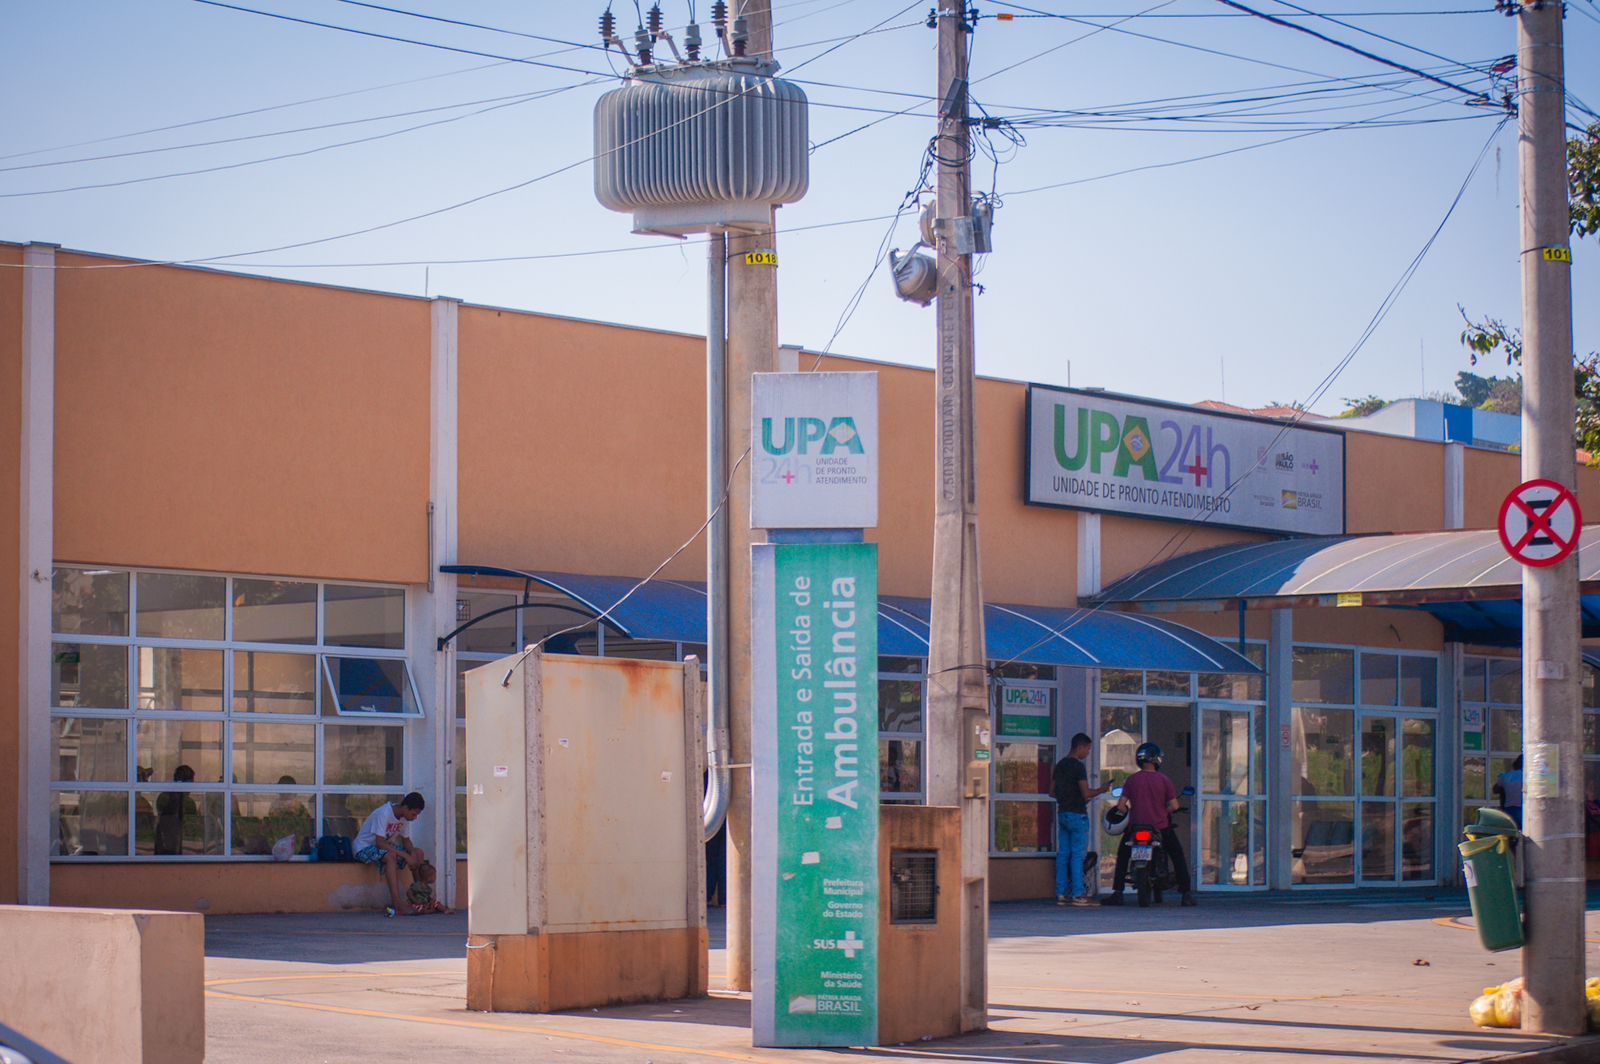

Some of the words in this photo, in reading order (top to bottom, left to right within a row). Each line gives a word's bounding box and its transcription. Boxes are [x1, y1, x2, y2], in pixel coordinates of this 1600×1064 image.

[747, 253, 777, 263] 1018
[761, 417, 865, 455] UPA
[761, 457, 812, 485] 24h
[827, 467, 856, 475] PRONTO
[816, 477, 867, 485] ATENDIMENTO
[1052, 475, 1099, 498] UNIDADE
[1102, 483, 1116, 500] DE
[1118, 485, 1159, 506] PRONTO
[1161, 489, 1231, 513] ATENDIMENTO
[1297, 498, 1323, 509] BRASIL
[789, 575, 811, 606] de
[790, 615, 812, 680] Saída
[797, 688, 813, 703] e
[823, 576, 858, 809] Ambulância
[792, 710, 814, 806] Entrada
[823, 879, 864, 887] Prefeitura
[823, 887, 864, 896] Municipal
[827, 901, 864, 909] Governo
[835, 910, 864, 918] Estado
[813, 938, 835, 950] SUS
[820, 971, 863, 980] Ministério
[824, 980, 835, 988] da
[836, 979, 863, 989] Saúde
[817, 1000, 863, 1012] BRASIL
